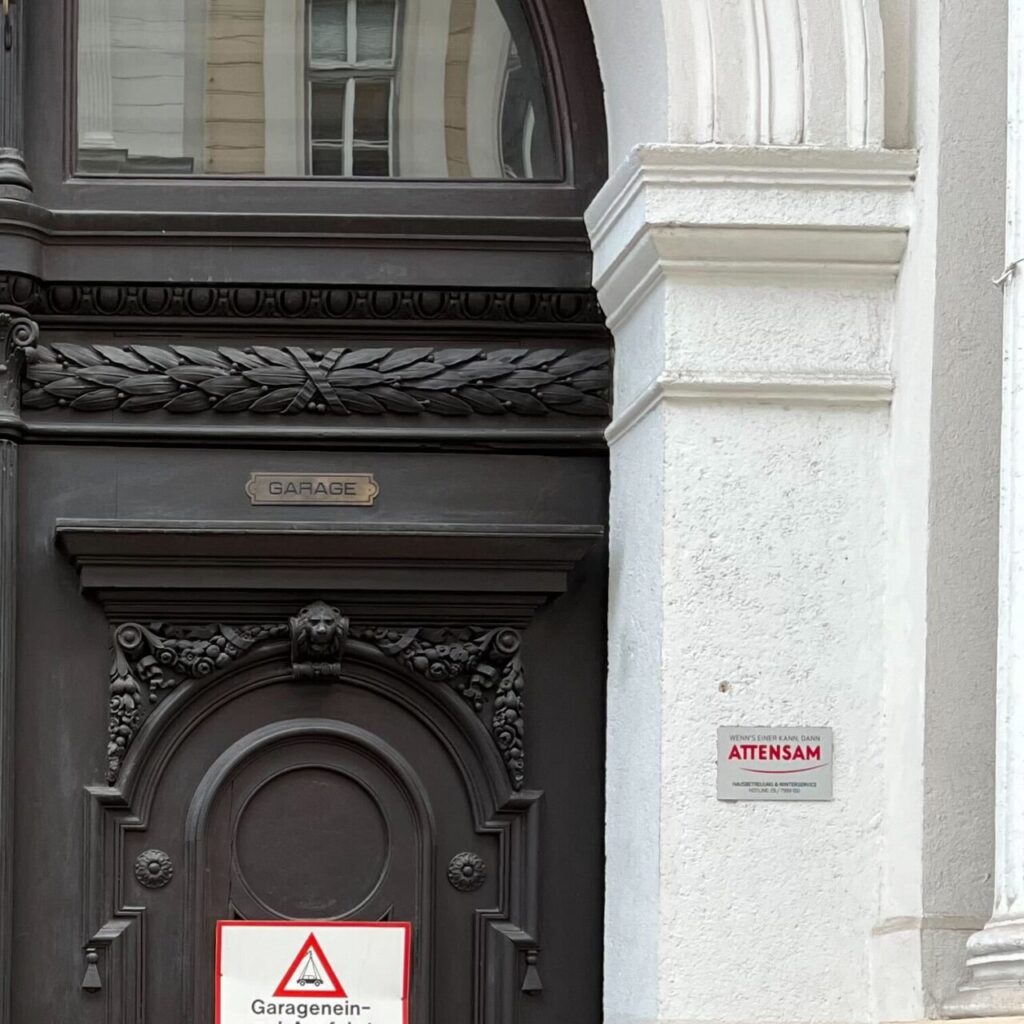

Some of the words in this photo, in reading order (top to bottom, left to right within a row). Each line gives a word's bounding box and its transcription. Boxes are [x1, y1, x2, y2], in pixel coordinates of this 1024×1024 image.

[268, 481, 358, 496] GARAGE
[728, 744, 821, 760] ATTENSAM
[251, 999, 372, 1018] Garagenein-
